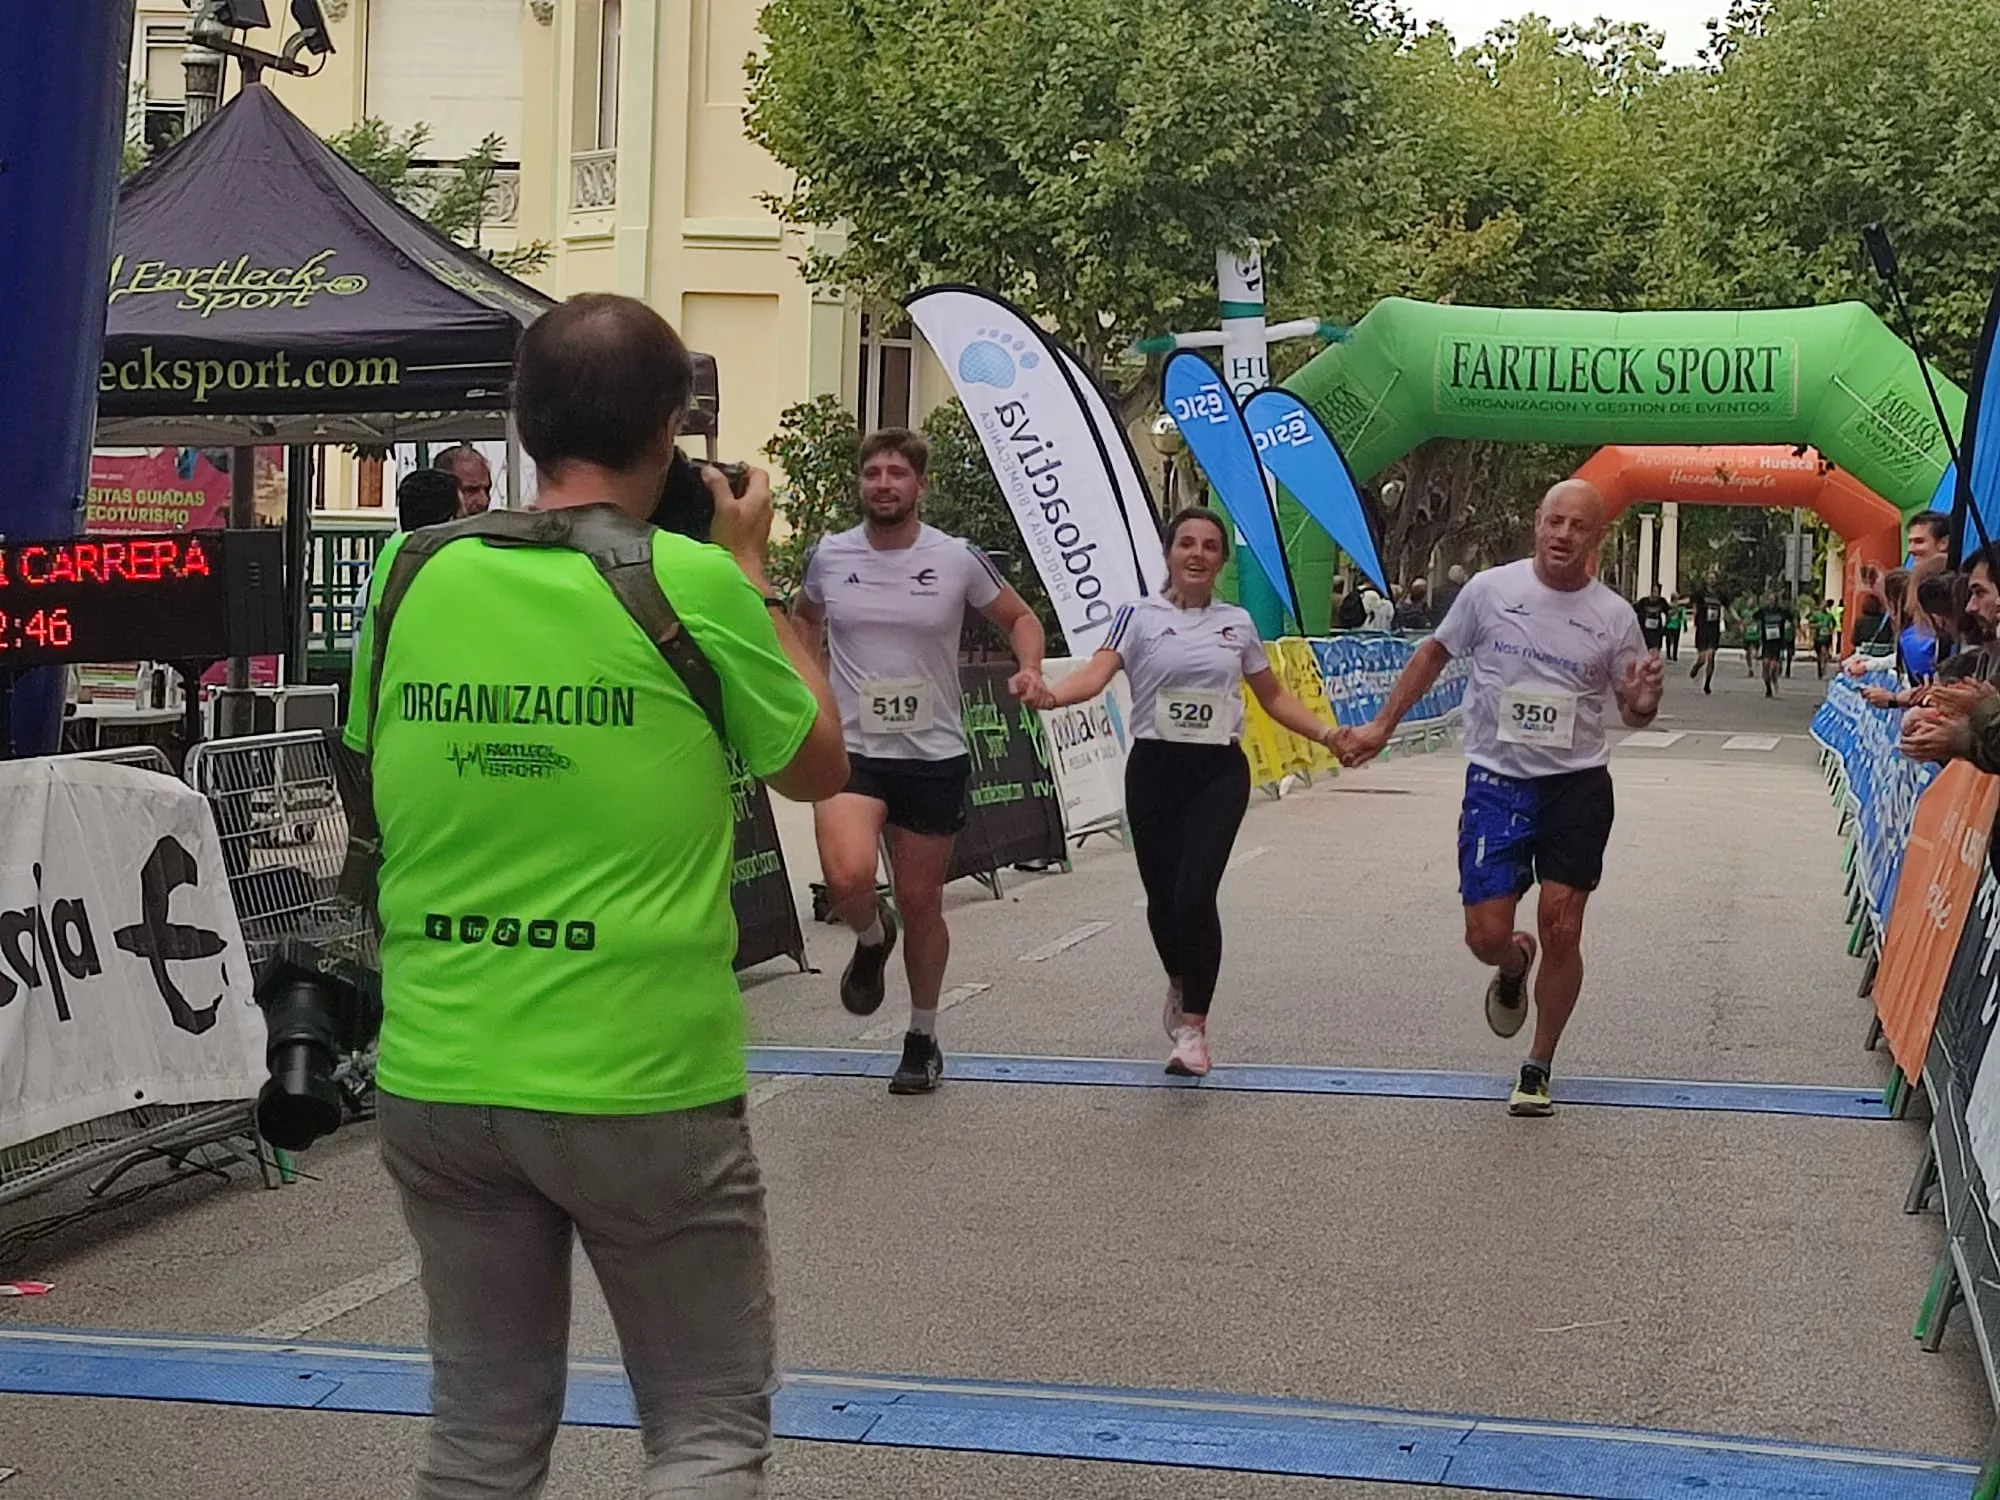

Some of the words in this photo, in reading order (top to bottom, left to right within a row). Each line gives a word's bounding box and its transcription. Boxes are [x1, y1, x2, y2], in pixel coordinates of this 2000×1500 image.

[1450, 342, 1645, 394] FARTLECK
[1655, 346, 1782, 395] SPORT
[1669, 403, 1691, 415] DE
[1738, 456, 1754, 468] de
[1759, 455, 1814, 471] Huesca
[20, 539, 209, 583] CARRERA
[402, 677, 634, 727] ORGANIZACIÓN
[872, 695, 918, 715] 519
[1169, 702, 1213, 722] 520
[1512, 703, 1557, 724] 350
[0, 863, 102, 1022] aja
